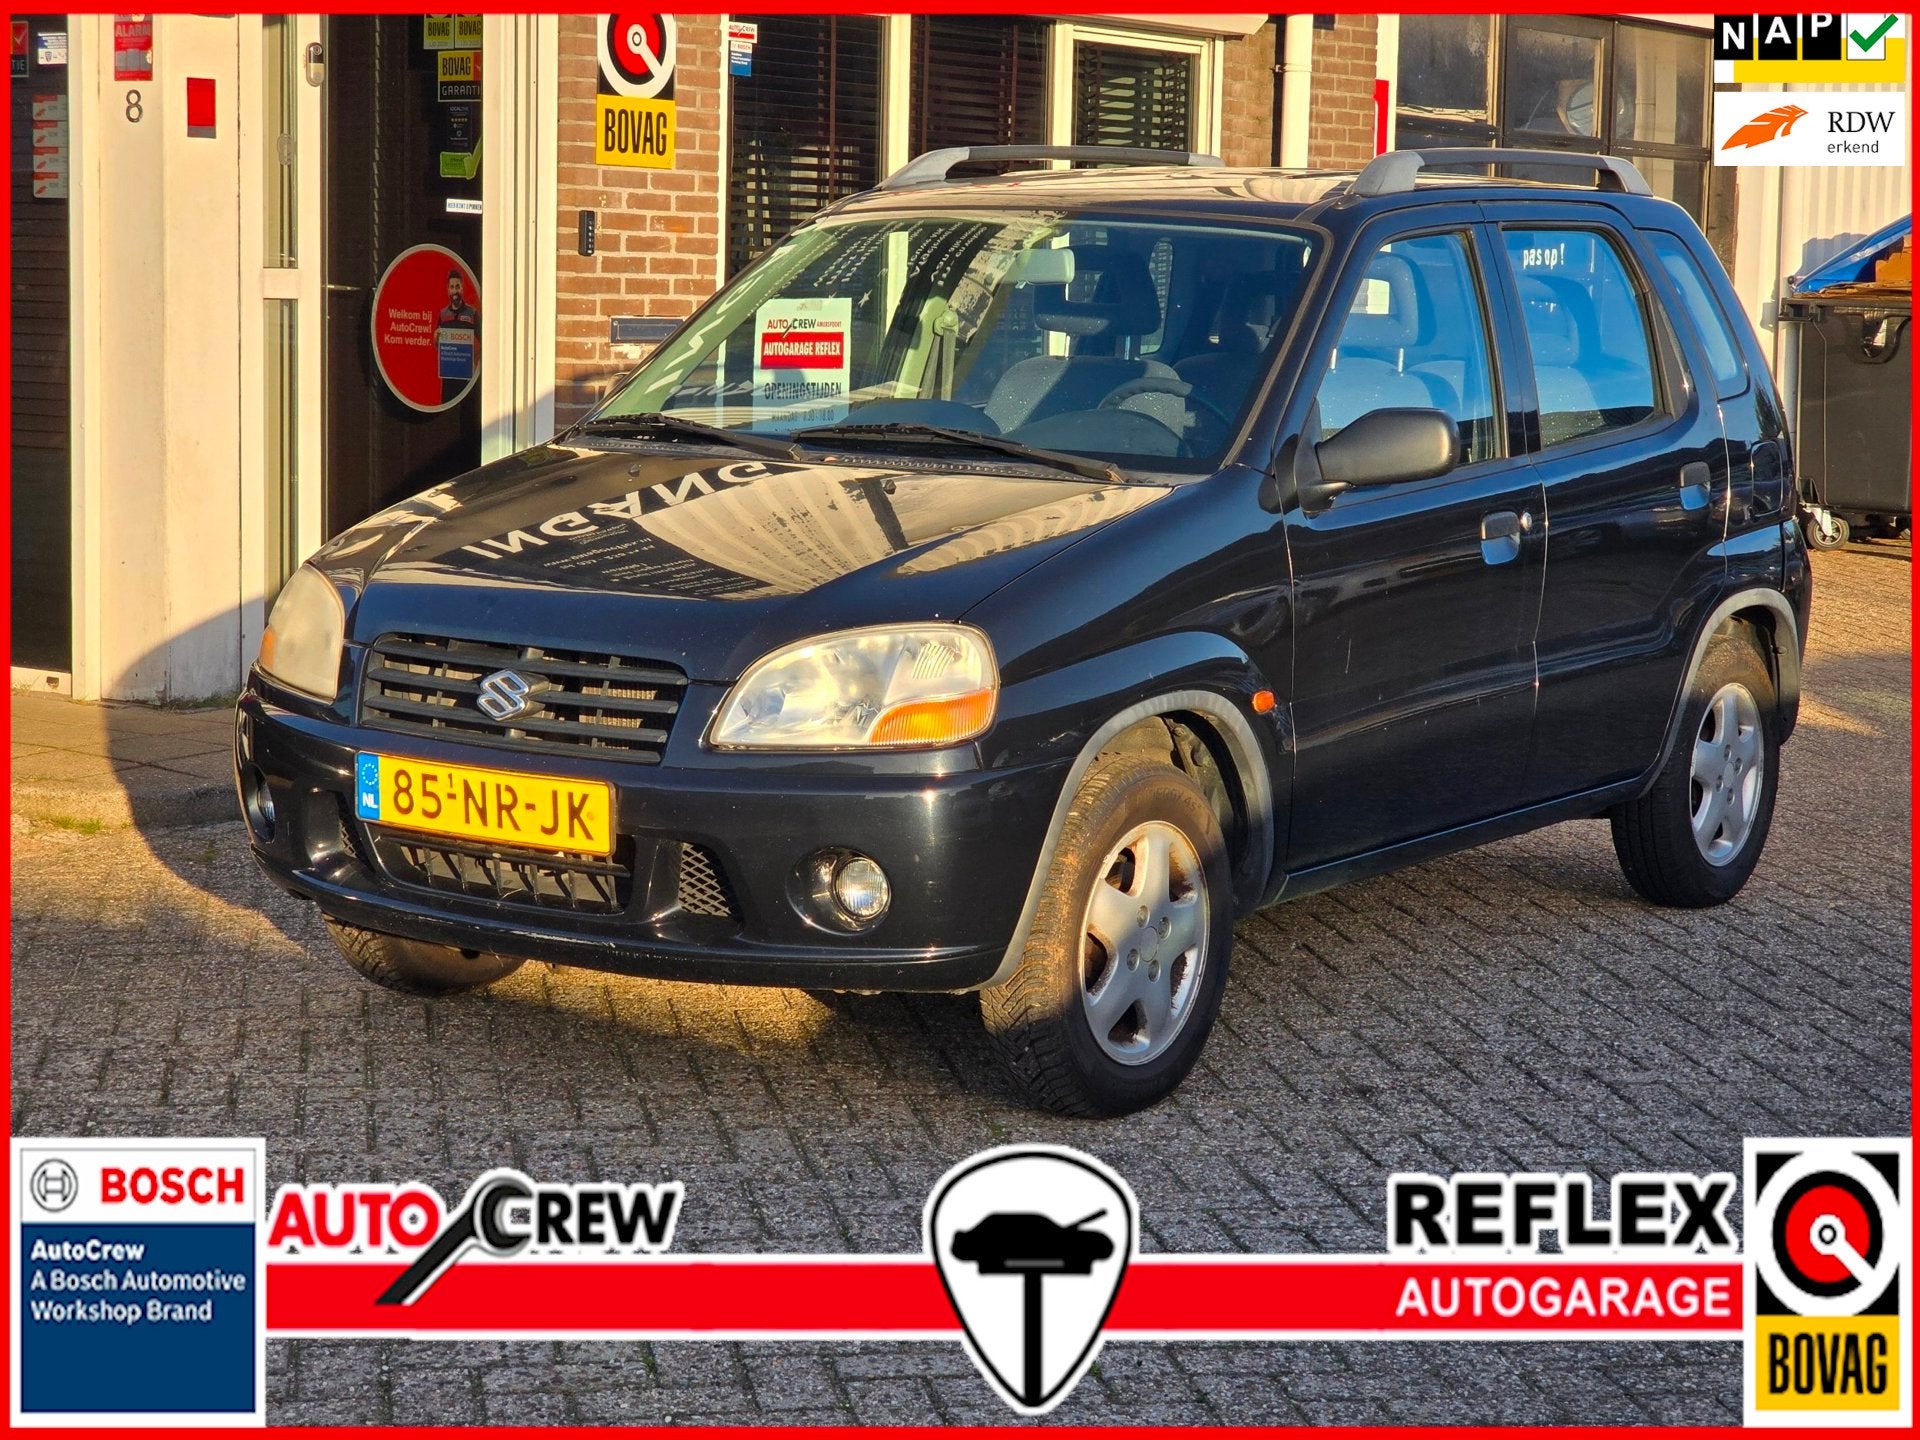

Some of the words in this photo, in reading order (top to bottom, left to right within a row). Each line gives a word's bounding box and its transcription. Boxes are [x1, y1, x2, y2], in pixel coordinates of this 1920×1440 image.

[428, 21, 450, 37] BOVAG
[459, 20, 482, 36] BOVAG
[442, 57, 471, 76] BOVAG
[126, 89, 143, 123] 8
[604, 108, 667, 156] BOVAG
[1523, 248, 1542, 270] pas
[388, 308, 421, 321] Welkom
[422, 309, 433, 323] bij
[390, 321, 432, 334] AutoCrew!
[767, 318, 789, 330] AUTO
[792, 318, 817, 330] CREW
[384, 333, 403, 345] Kom
[404, 335, 432, 346] verder.
[450, 333, 472, 341] BOSCH
[763, 342, 814, 356] AUTOGARAGE
[815, 341, 841, 356] REFLEX
[362, 791, 378, 809] NL
